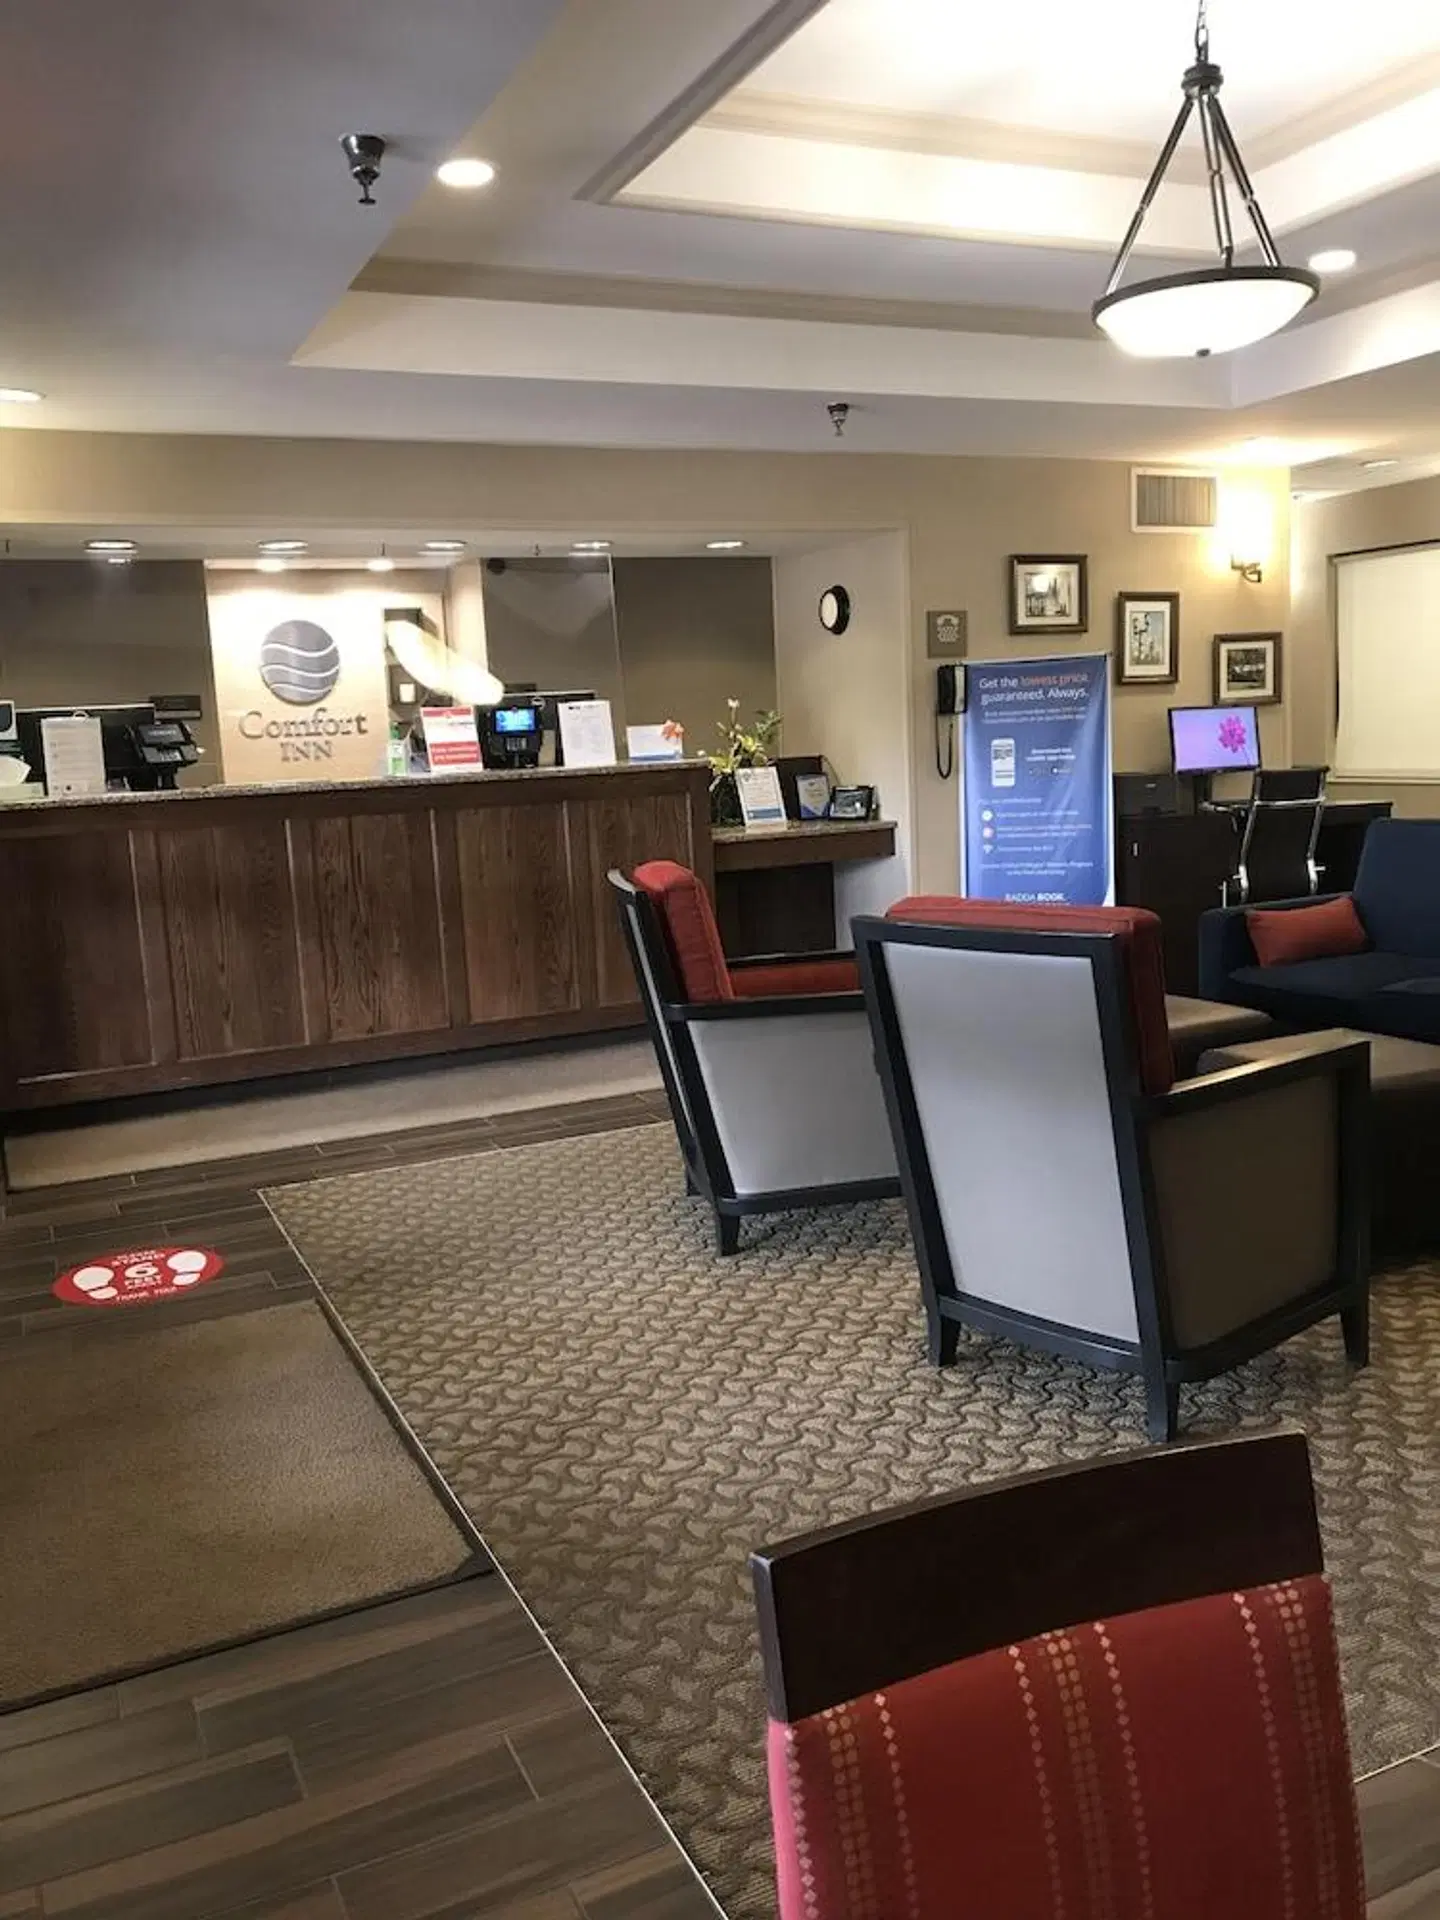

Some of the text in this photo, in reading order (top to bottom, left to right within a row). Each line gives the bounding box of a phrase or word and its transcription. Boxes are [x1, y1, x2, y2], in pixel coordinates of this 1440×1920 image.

[979, 678, 997, 689] Get
[1000, 677, 1018, 688] the
[238, 707, 368, 739] Comfort
[279, 740, 333, 762] INN
[124, 1261, 160, 1278] 6
